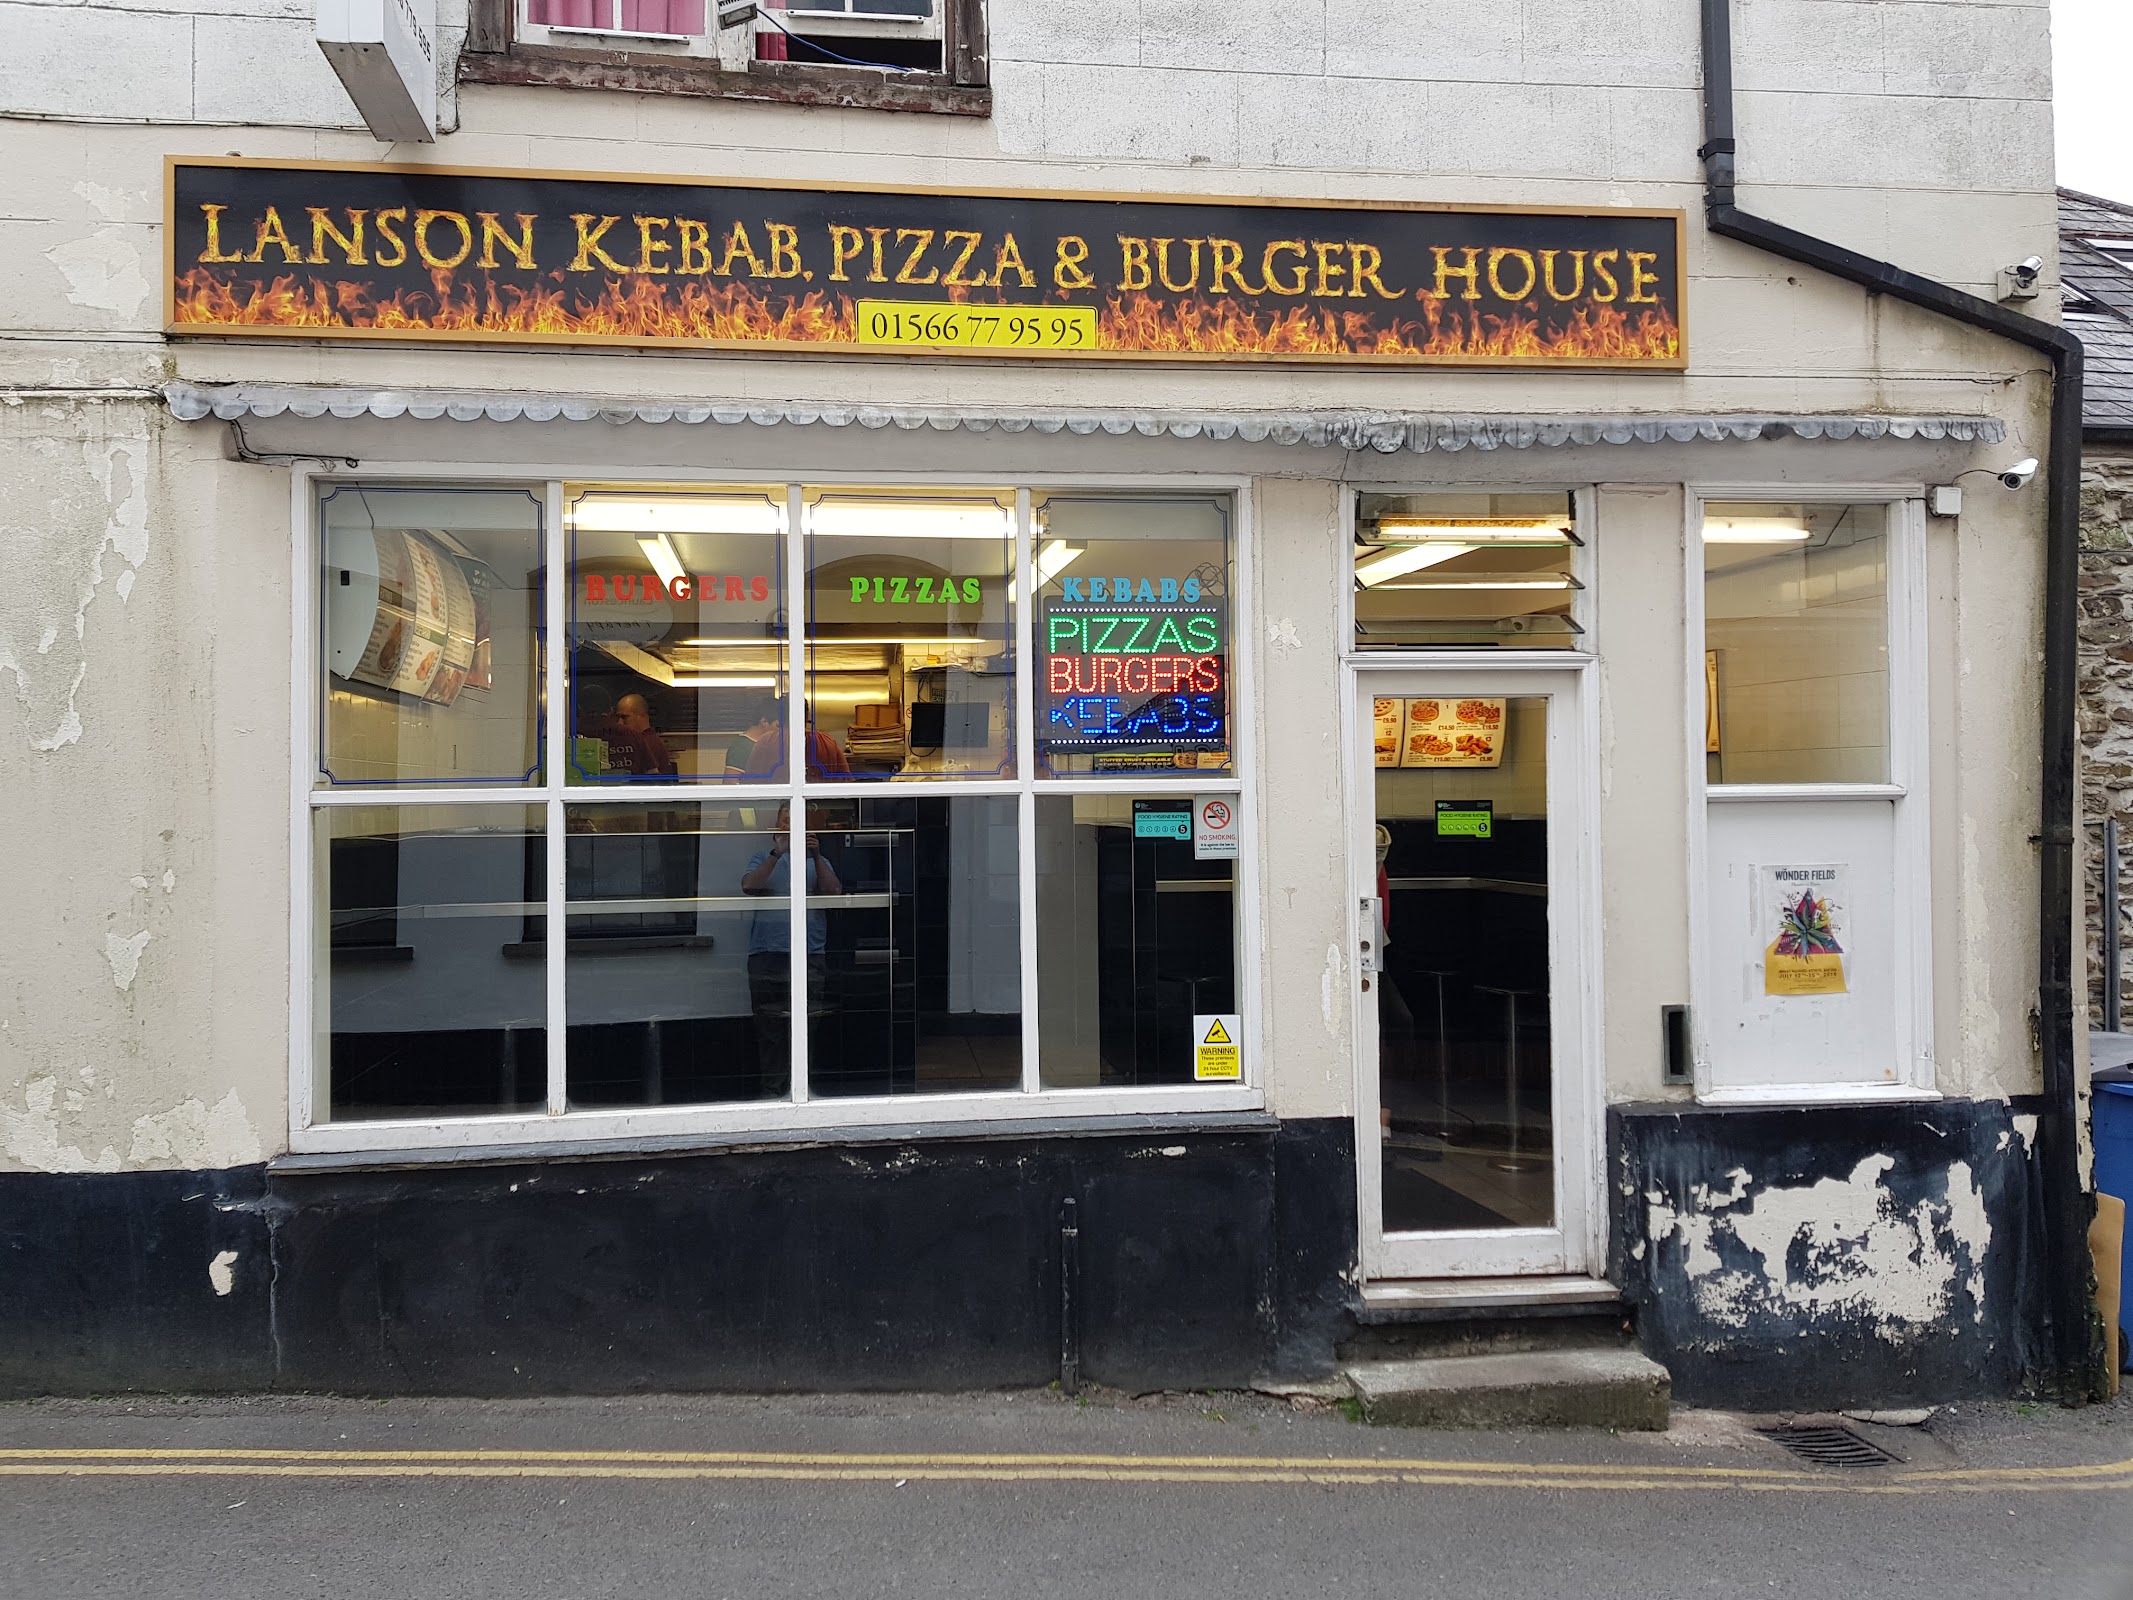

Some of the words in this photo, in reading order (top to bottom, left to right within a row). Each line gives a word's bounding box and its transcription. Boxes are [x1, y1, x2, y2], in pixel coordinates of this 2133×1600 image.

[419, 26, 431, 63] 595
[198, 203, 537, 270] LANSON
[827, 223, 1037, 290] PIZZA
[1054, 234, 1096, 290] &
[1116, 231, 1405, 299] BURGER
[1428, 245, 1661, 303] HOUSE
[871, 312, 959, 341] 01566
[967, 316, 1000, 344] 77
[1009, 317, 1041, 345] 95
[1051, 318, 1083, 346] 95
[585, 574, 769, 602] BURGERS
[849, 576, 982, 604] PIZZAS
[1062, 576, 1201, 604] KEBABS
[1049, 617, 1218, 654] PIZZAS
[1049, 656, 1220, 694] BURGERS
[1049, 697, 1219, 735] KEBABS
[609, 744, 634, 755] son
[1811, 869, 1836, 880] FIELDS
